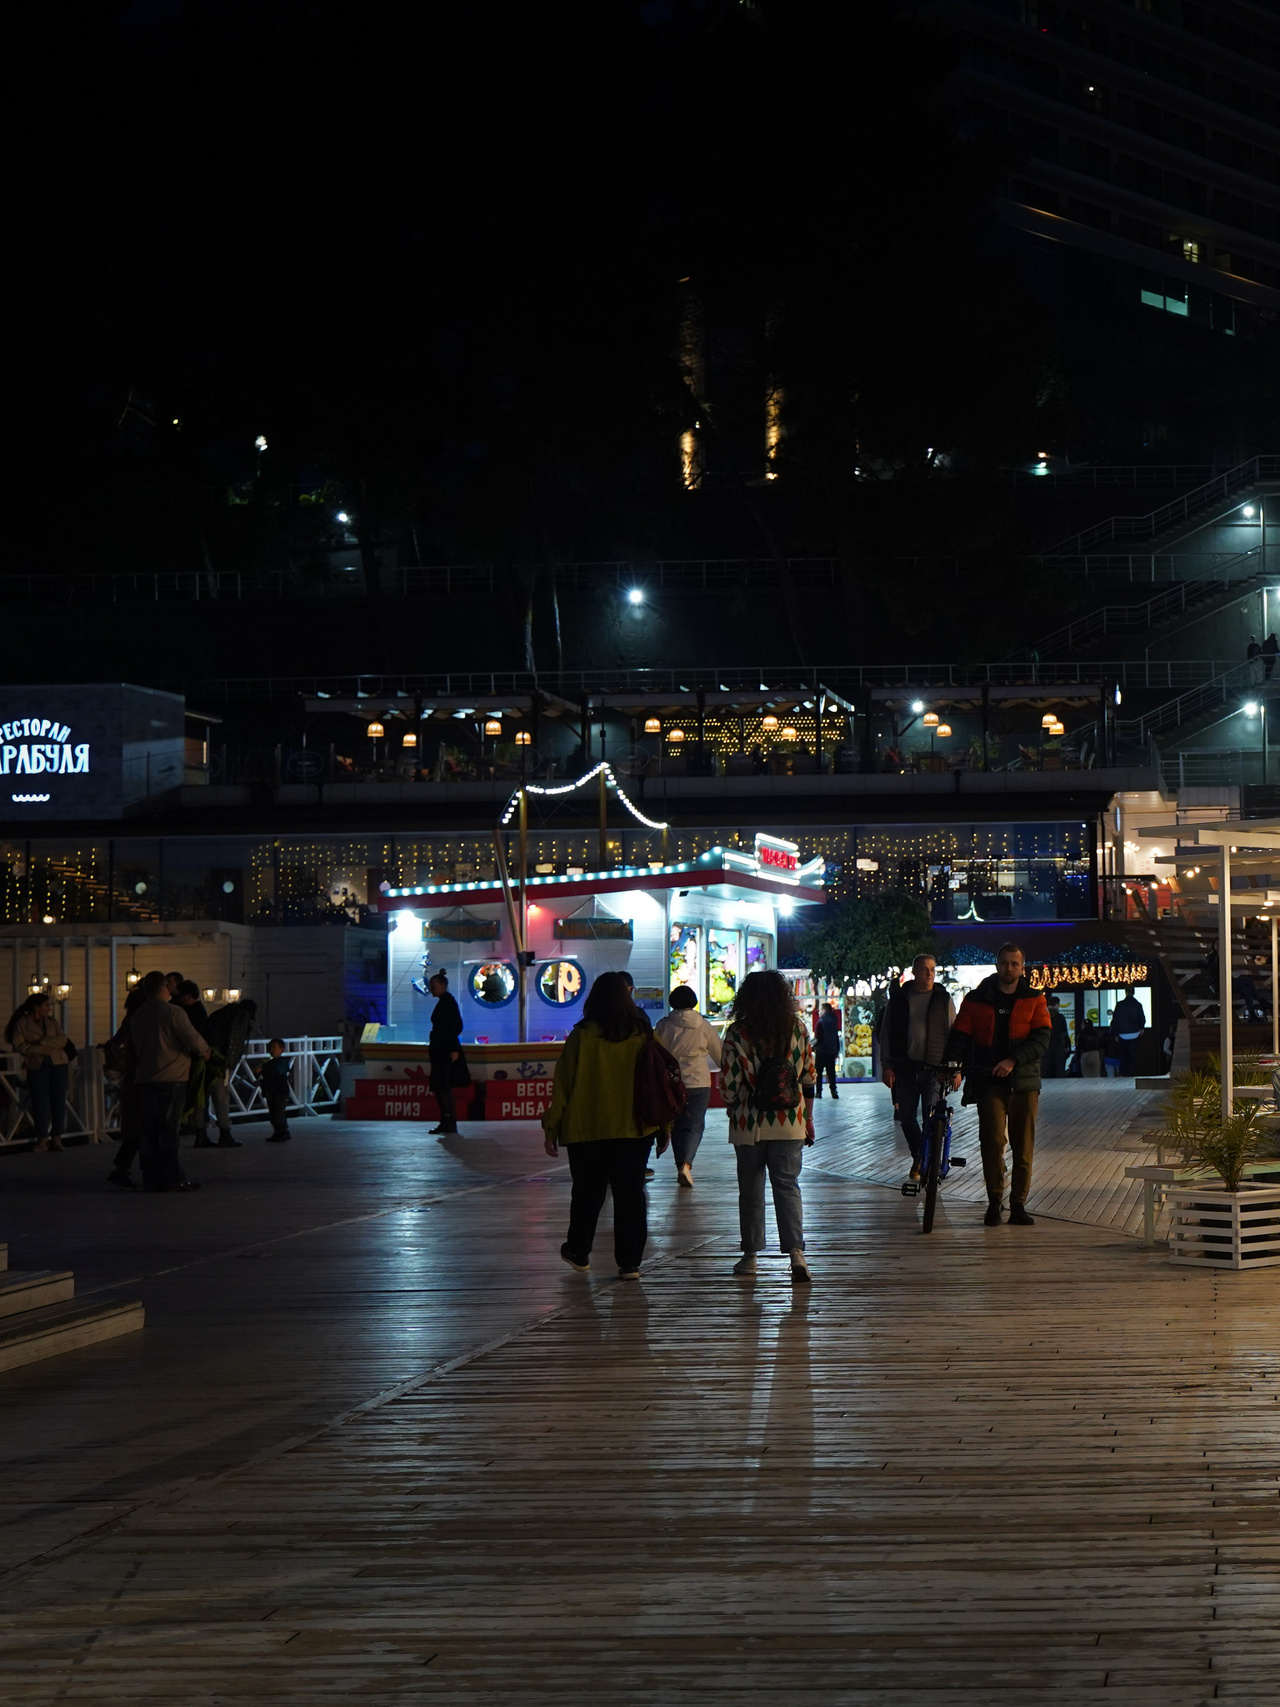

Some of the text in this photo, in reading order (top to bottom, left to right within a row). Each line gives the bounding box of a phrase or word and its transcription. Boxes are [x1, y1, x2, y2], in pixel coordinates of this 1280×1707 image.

[0, 743, 90, 775] РАБУЛЯ
[377, 1084, 434, 1097] ВЫИГРА
[516, 1080, 553, 1097] ВЕСЁ
[385, 1101, 421, 1117] ПРИЗ
[501, 1101, 553, 1117] РЫБА
